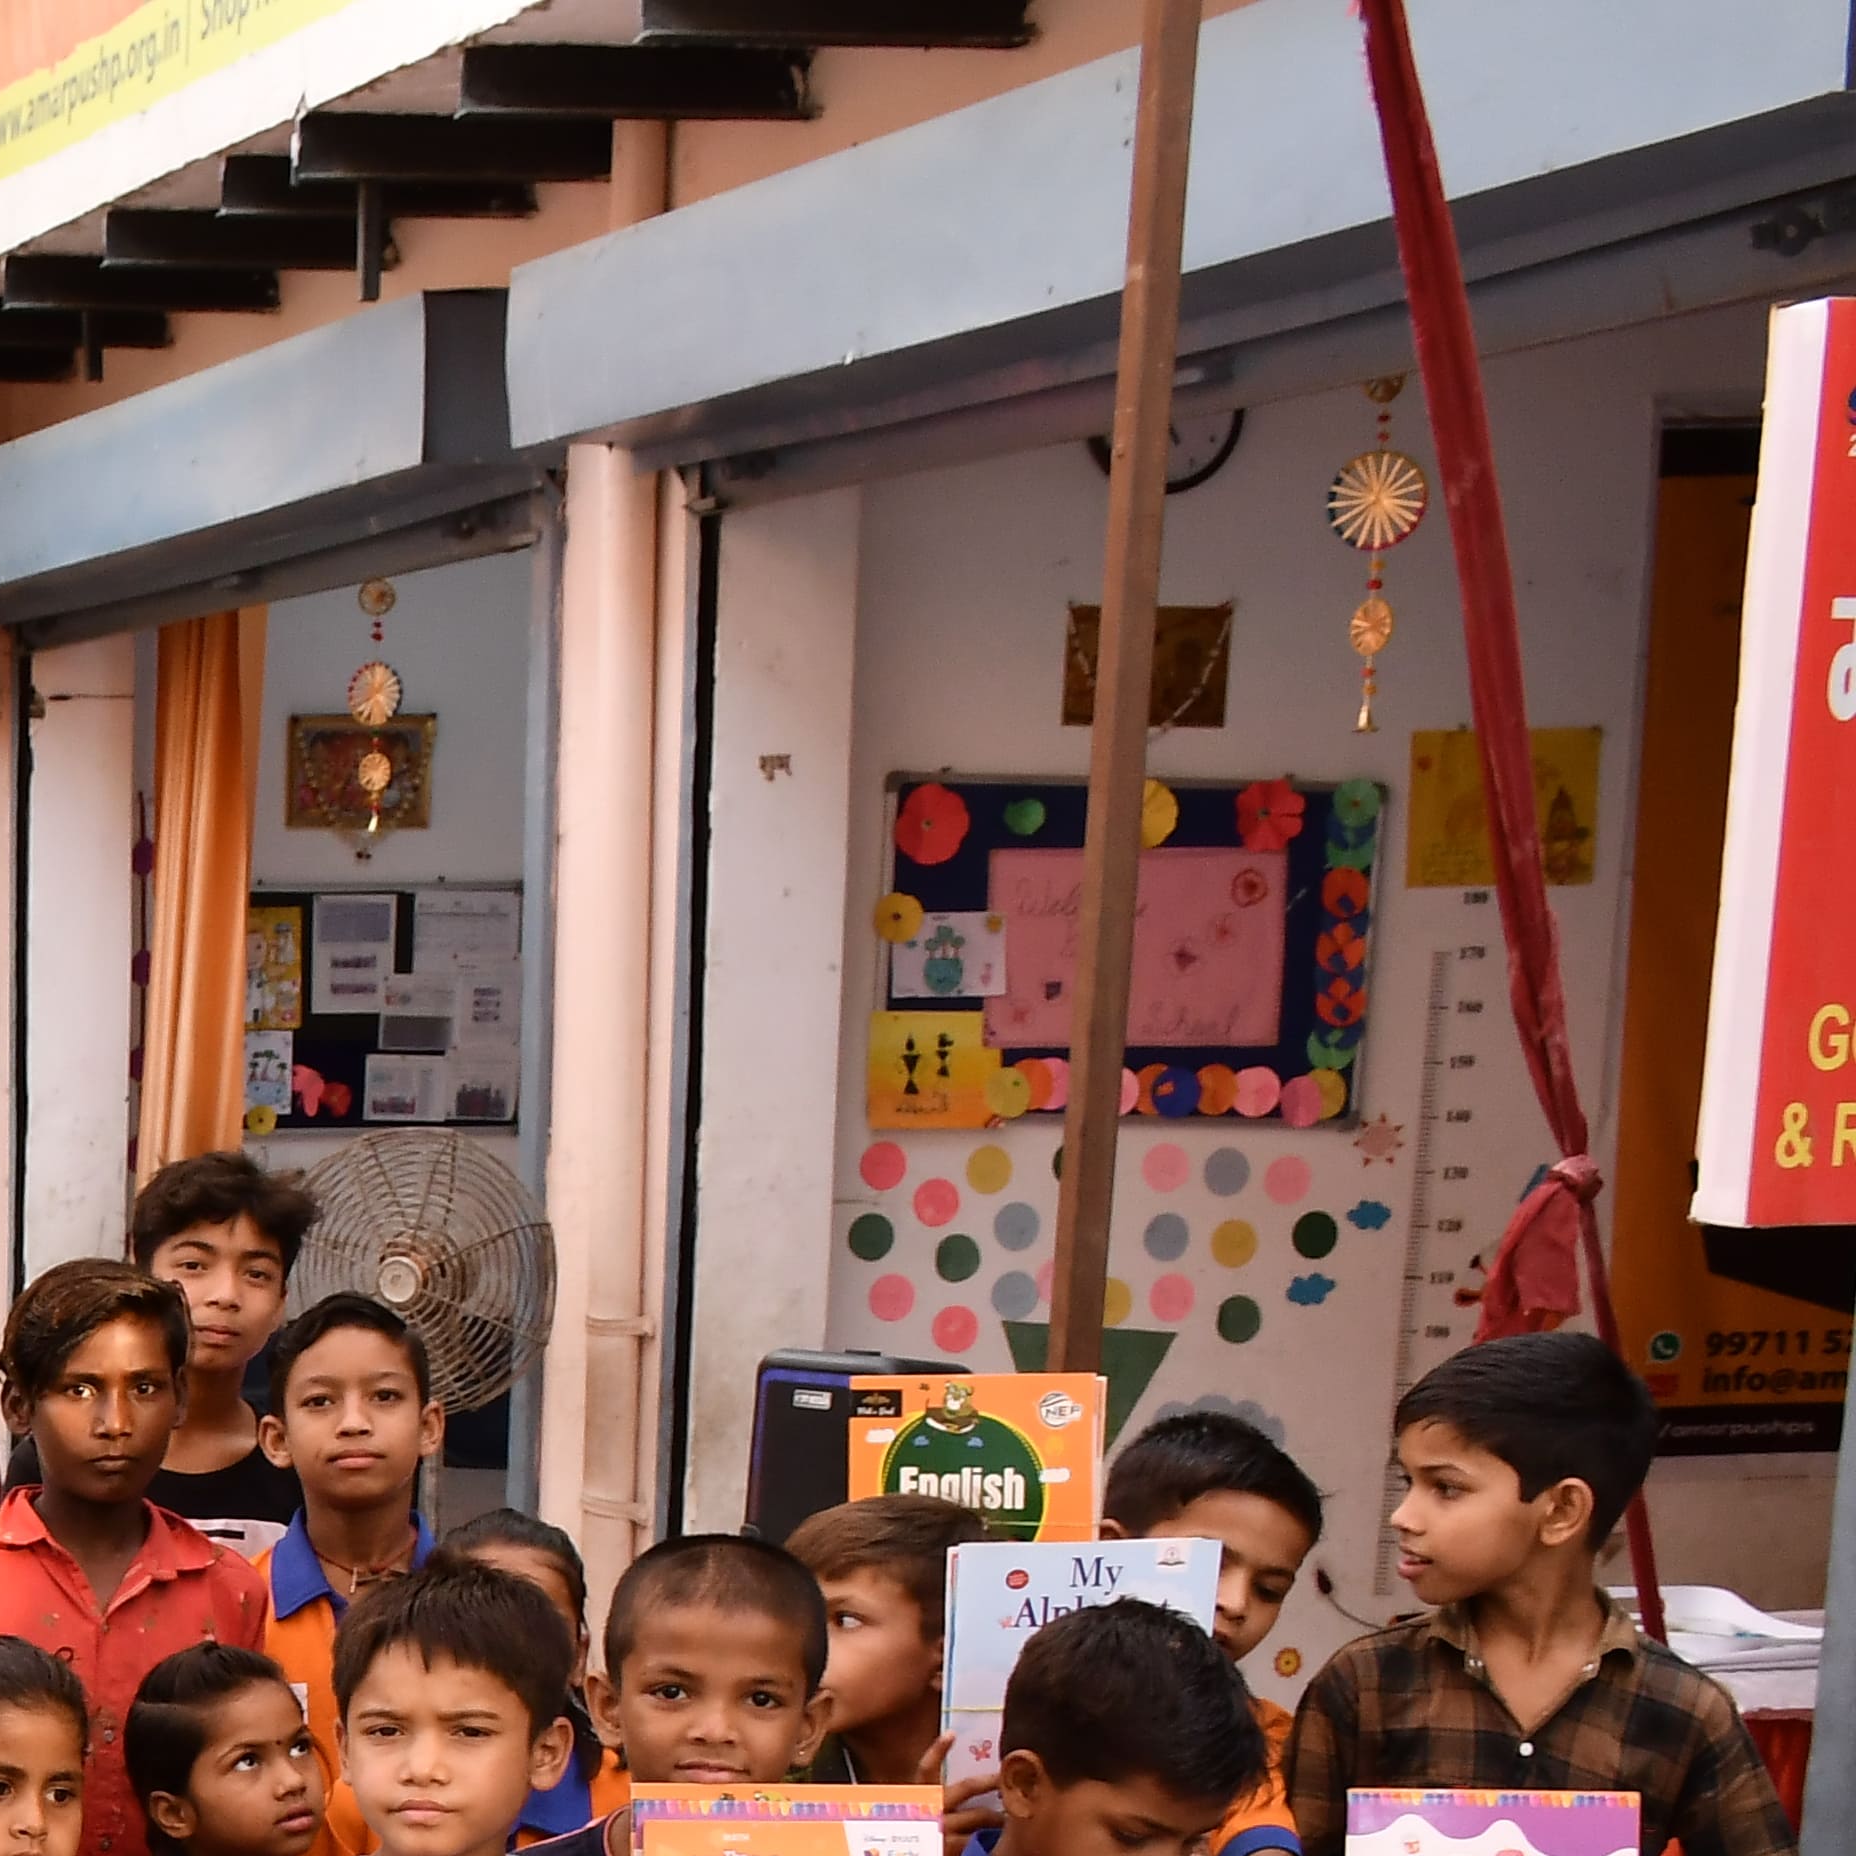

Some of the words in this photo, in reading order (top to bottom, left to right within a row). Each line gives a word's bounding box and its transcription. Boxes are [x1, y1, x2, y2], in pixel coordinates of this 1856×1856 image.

[1774, 1102, 1813, 1169] &
[899, 1466, 1026, 1511] English
[1069, 1556, 1124, 1596] My
